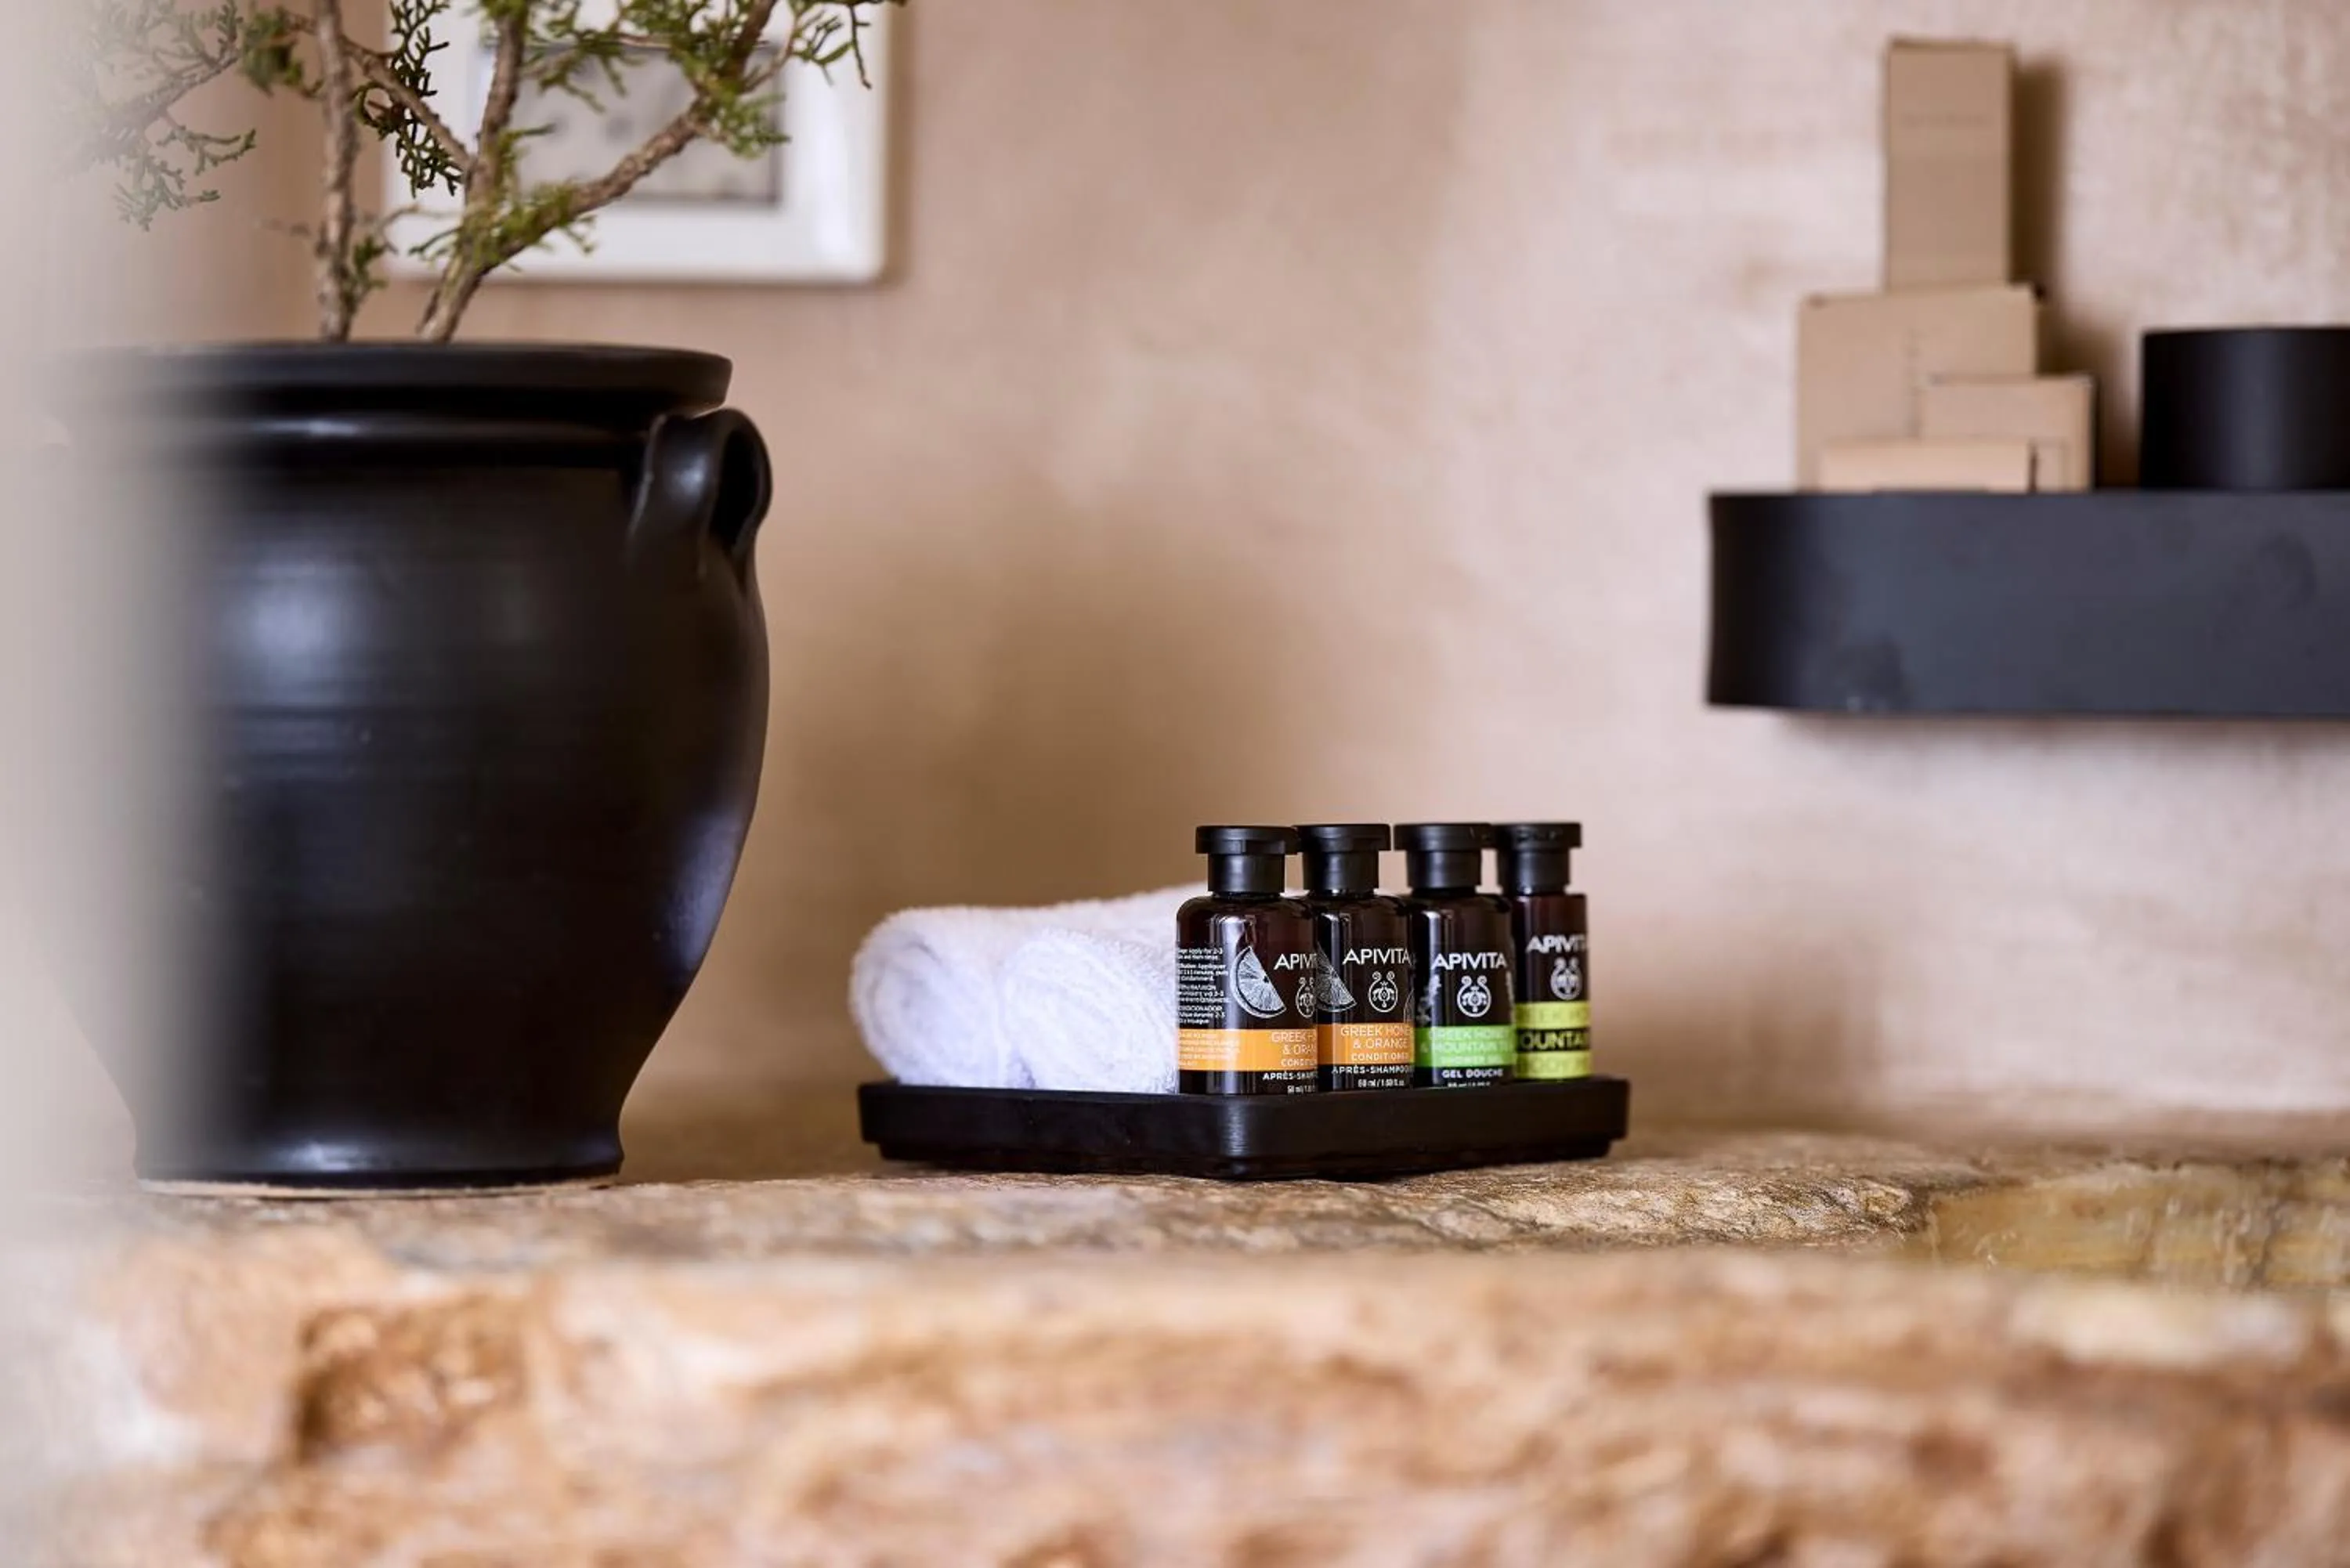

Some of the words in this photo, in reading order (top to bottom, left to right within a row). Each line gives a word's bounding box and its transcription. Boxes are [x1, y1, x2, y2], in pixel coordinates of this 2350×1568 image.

[1342, 948, 1411, 965] APIVITA
[1431, 952, 1507, 970] APIVITA
[1340, 1025, 1383, 1037] GREEK
[1365, 1038, 1408, 1049] ORANGE
[1442, 1070, 1463, 1078] GEL
[1466, 1068, 1503, 1078] DOUCHE
